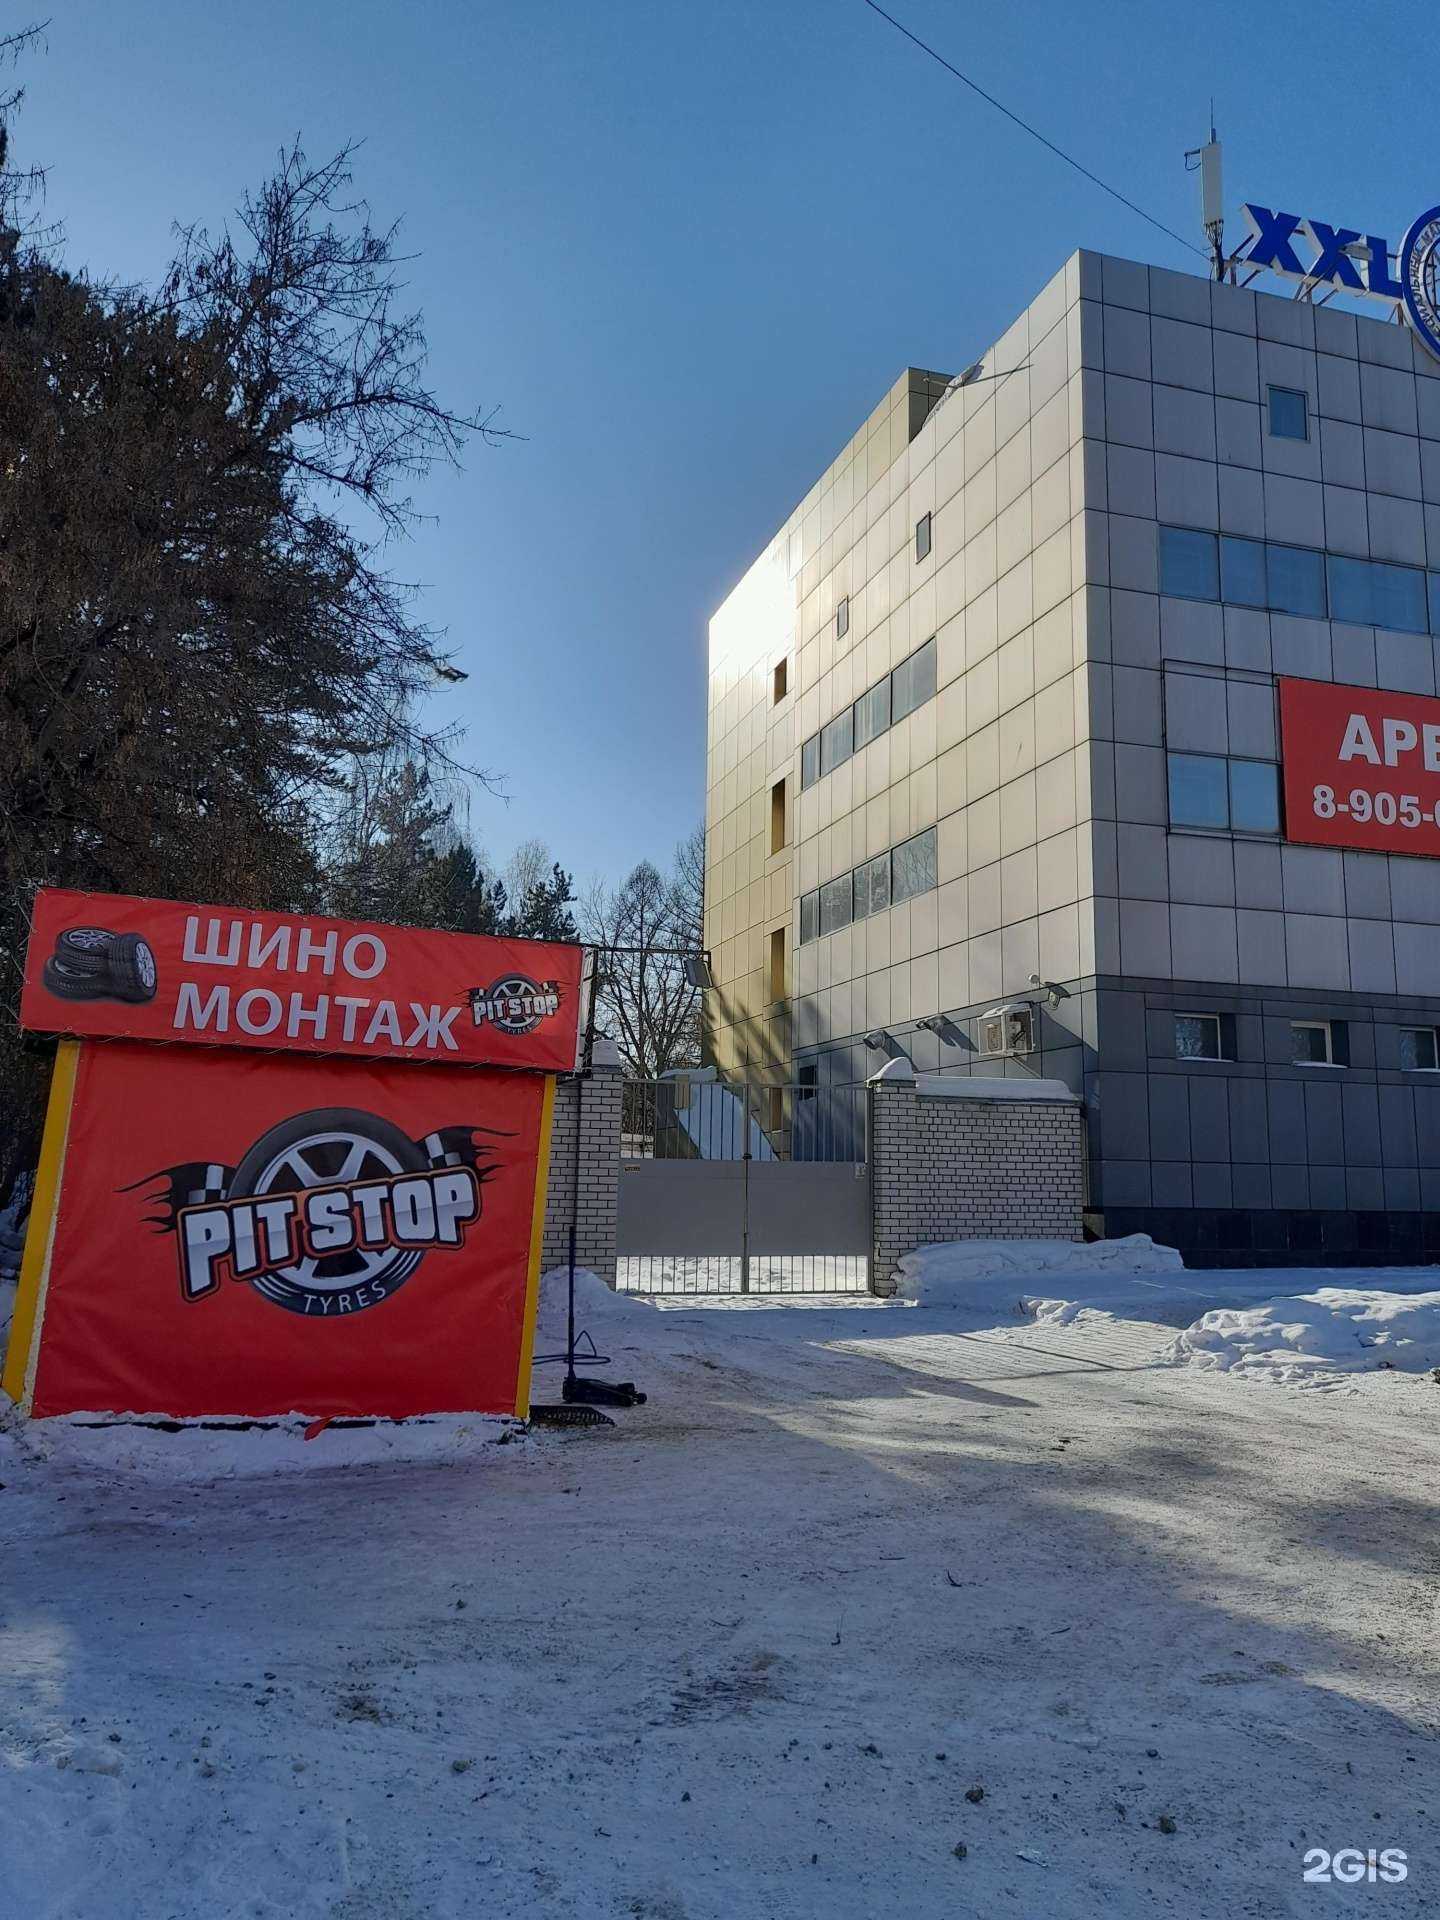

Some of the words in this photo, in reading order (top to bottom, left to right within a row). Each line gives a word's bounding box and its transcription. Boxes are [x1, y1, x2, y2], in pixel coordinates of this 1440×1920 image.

[1243, 203, 1404, 299] XXL
[183, 916, 387, 979] ШИНО
[173, 982, 462, 1051] МОНТАЖ
[473, 998, 505, 1026] PIT
[508, 994, 559, 1017] STOP
[184, 1199, 294, 1295] PIT
[307, 1172, 476, 1251] STOP
[303, 1279, 388, 1315] TYRES
